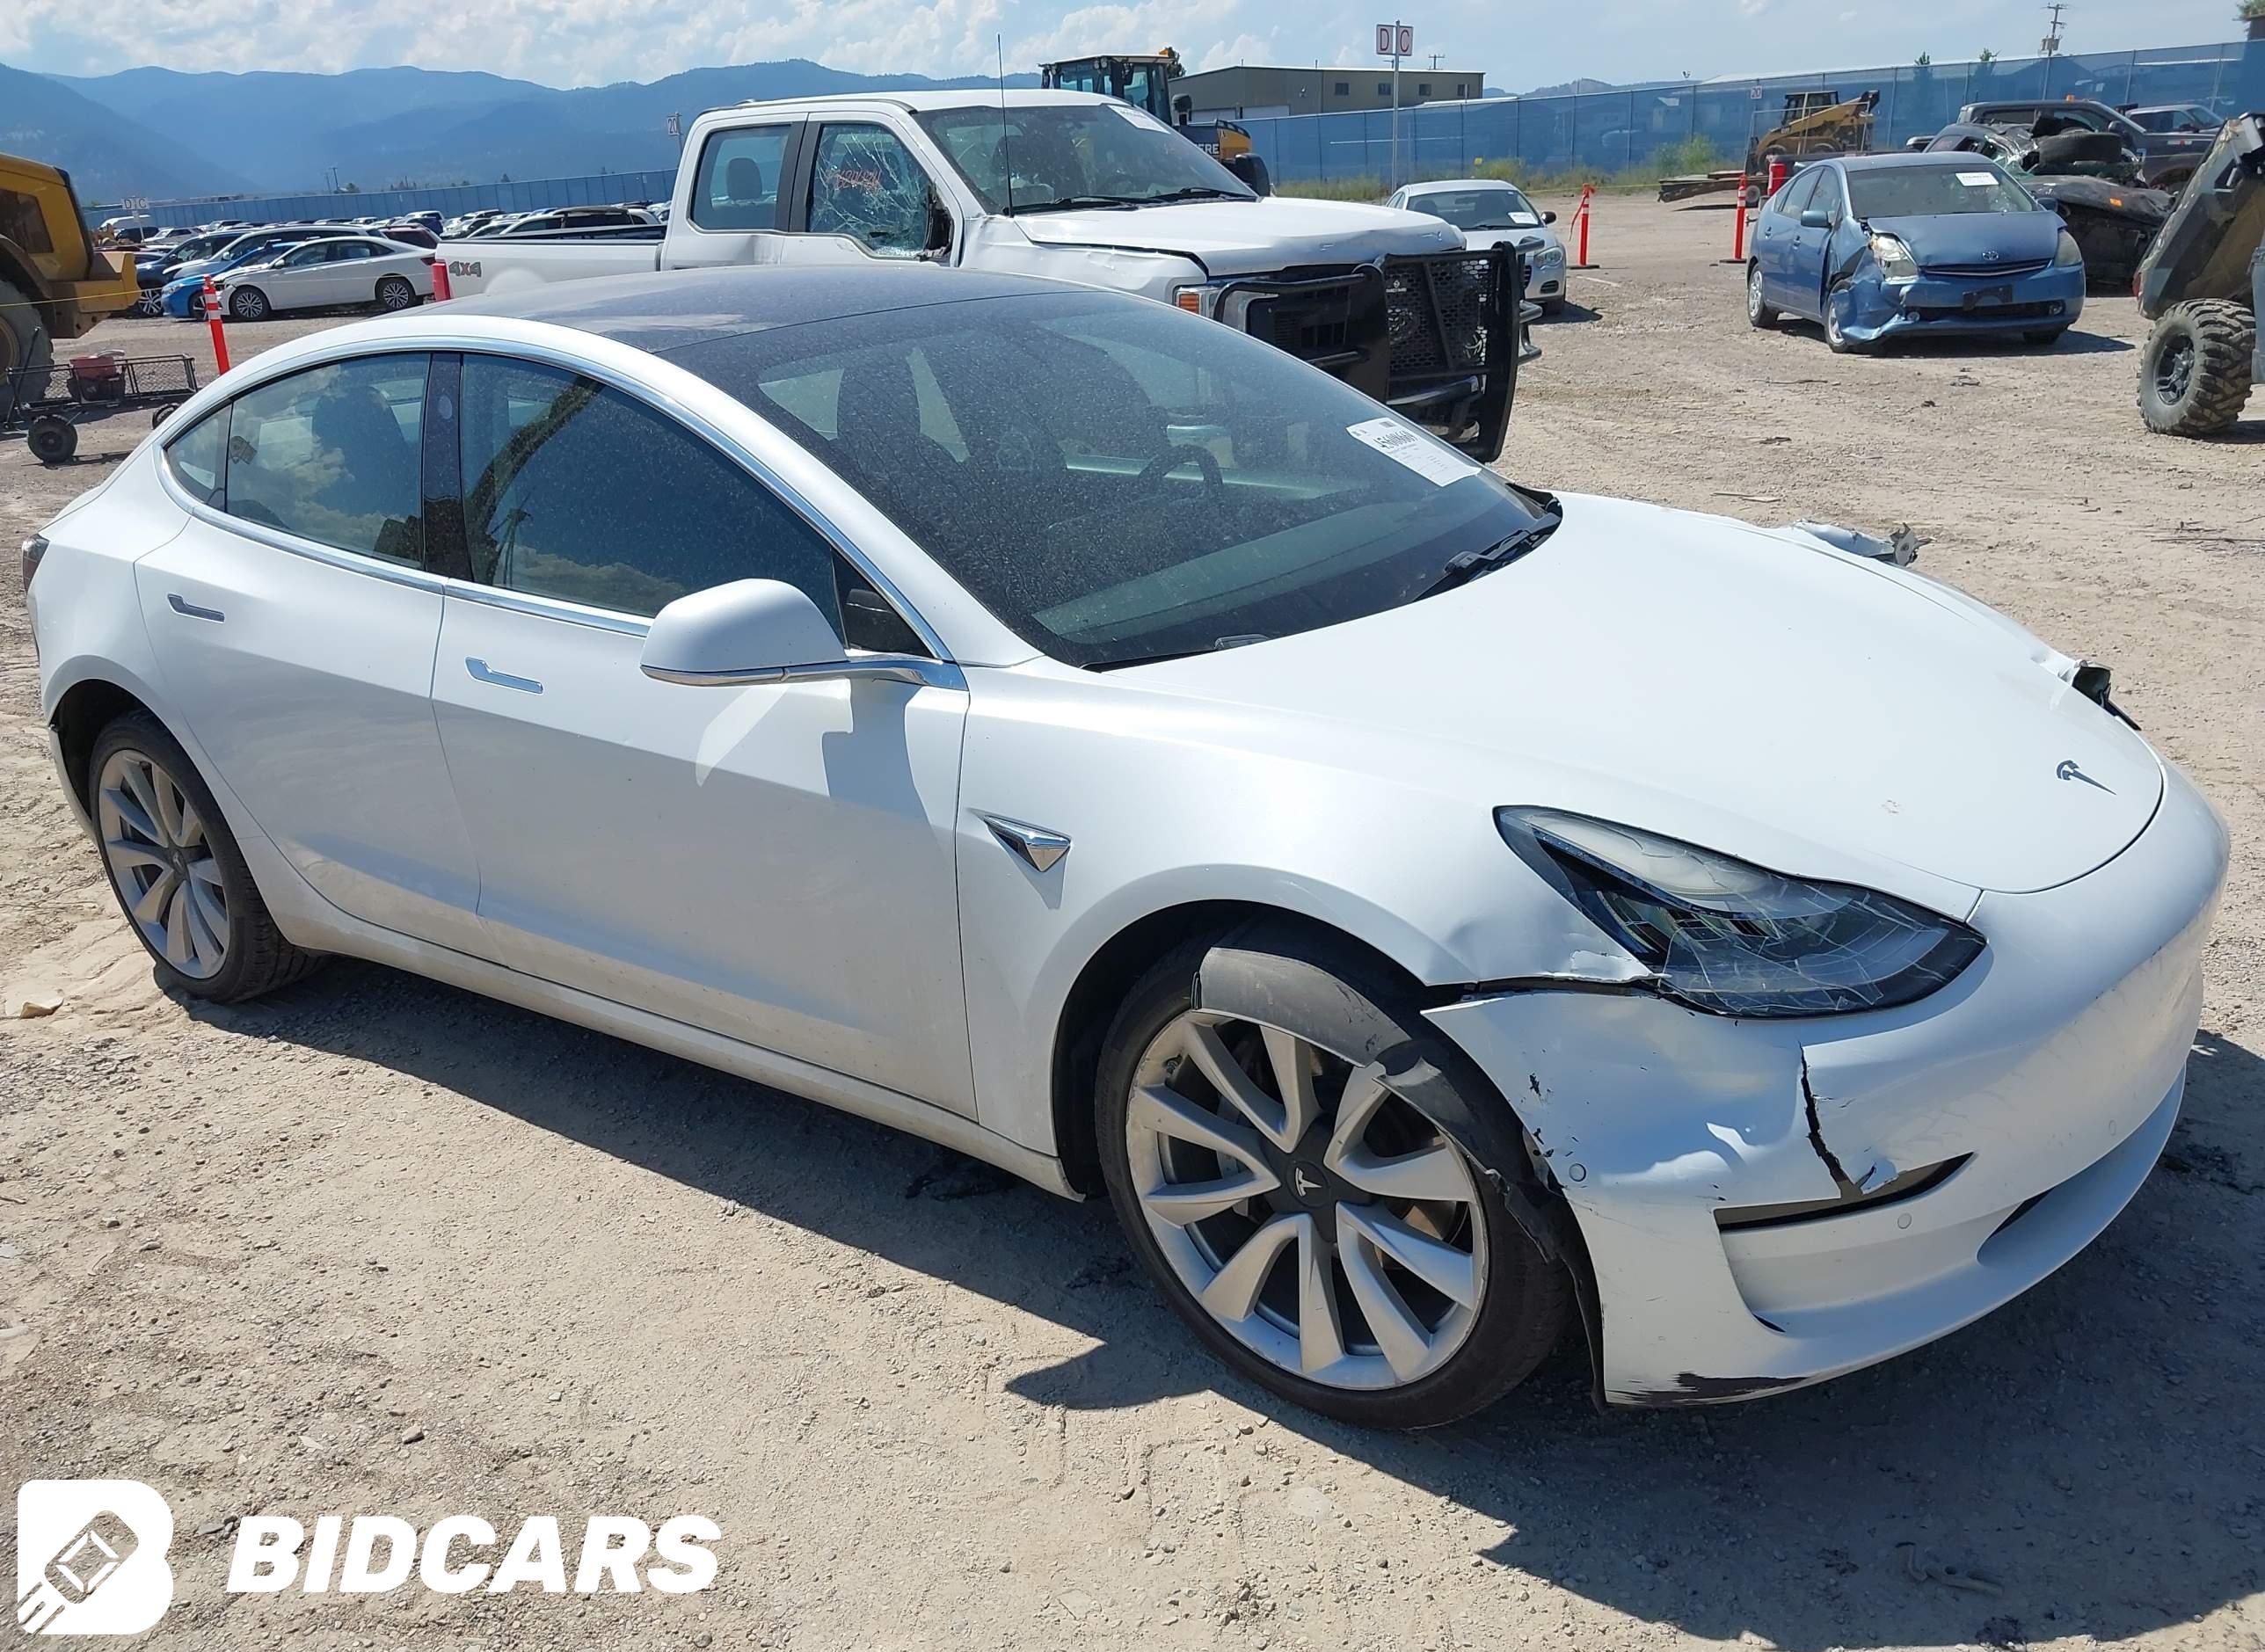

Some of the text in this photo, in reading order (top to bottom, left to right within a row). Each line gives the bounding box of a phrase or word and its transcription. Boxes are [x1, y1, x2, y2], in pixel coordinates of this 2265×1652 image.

[1380, 27, 1410, 53] D C
[1195, 143, 1220, 155] ERE
[124, 198, 147, 208] D C
